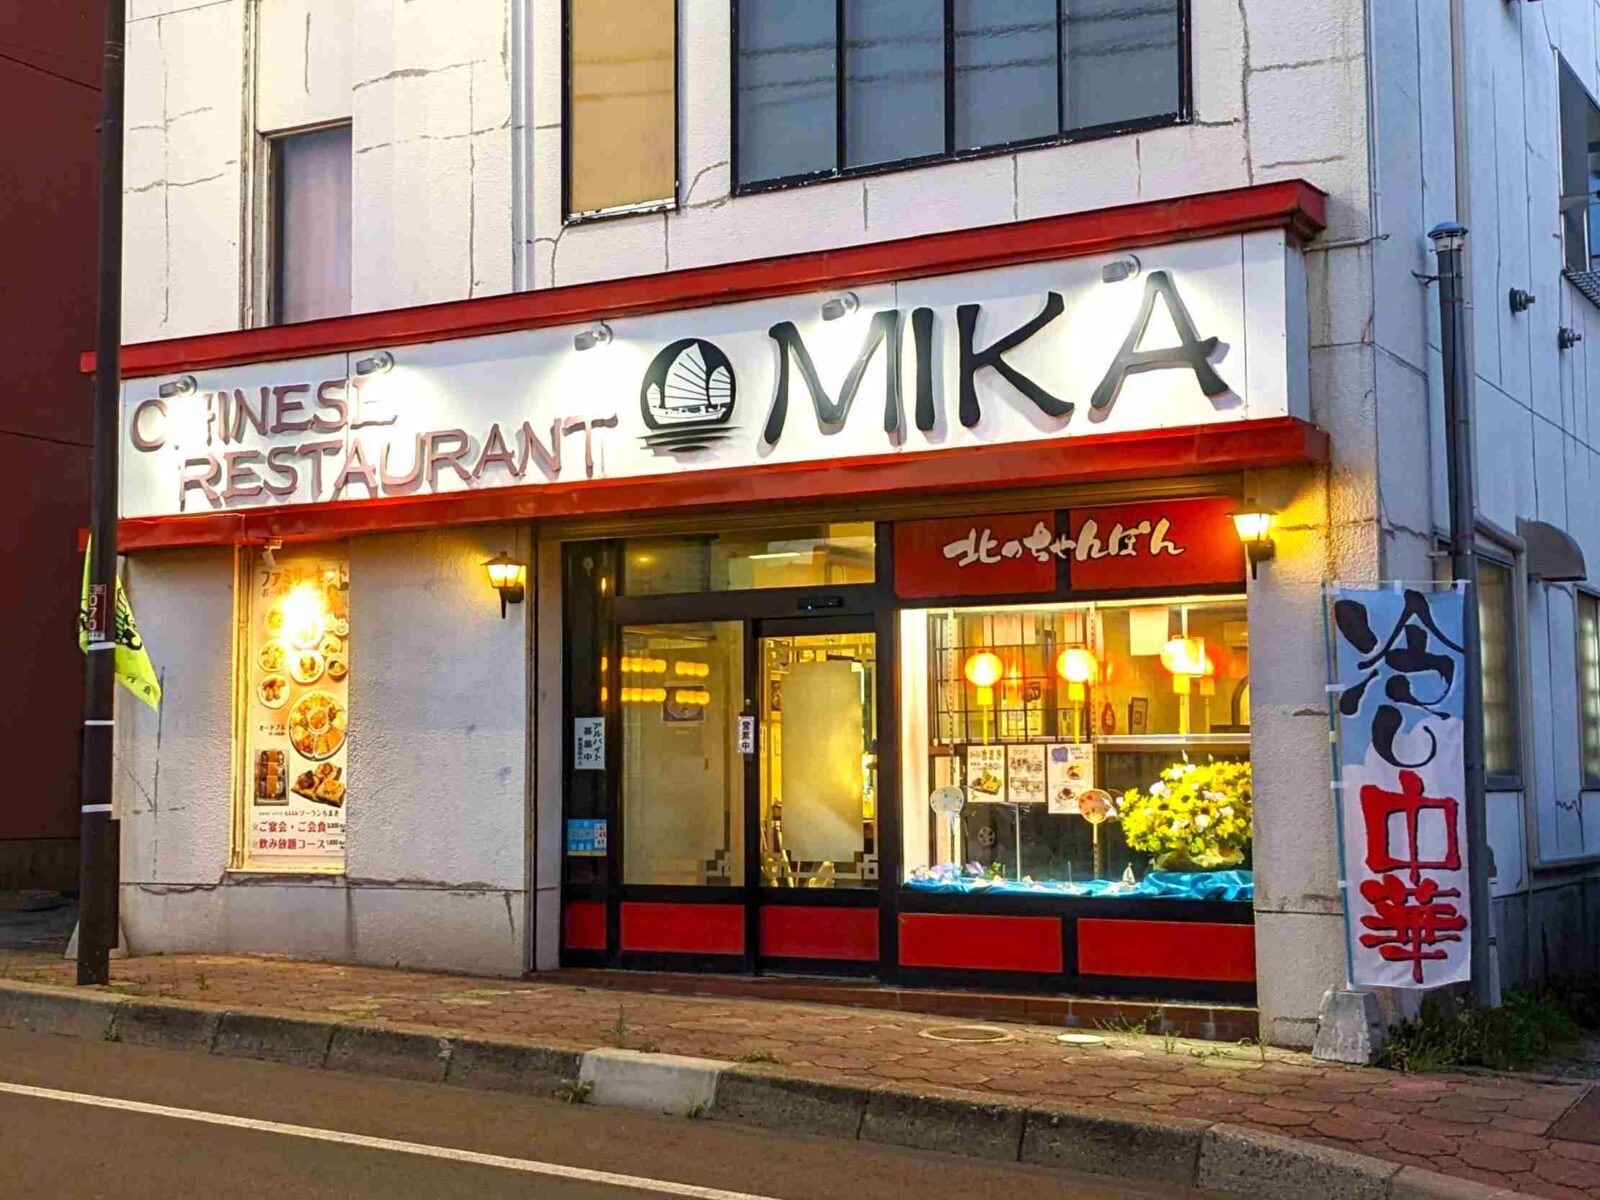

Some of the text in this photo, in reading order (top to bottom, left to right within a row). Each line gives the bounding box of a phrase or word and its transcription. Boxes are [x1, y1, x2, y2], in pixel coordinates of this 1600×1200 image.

[763, 270, 1230, 446] MIKA
[179, 413, 618, 511] RESTAURANT
[943, 517, 1186, 567] 北のちゃんぽん
[592, 722, 602, 761] アルバイト
[1335, 588, 1468, 983] 冷し中華
[259, 821, 326, 833] ご宴会・ご会食
[259, 838, 325, 849] 飲み放題コース
